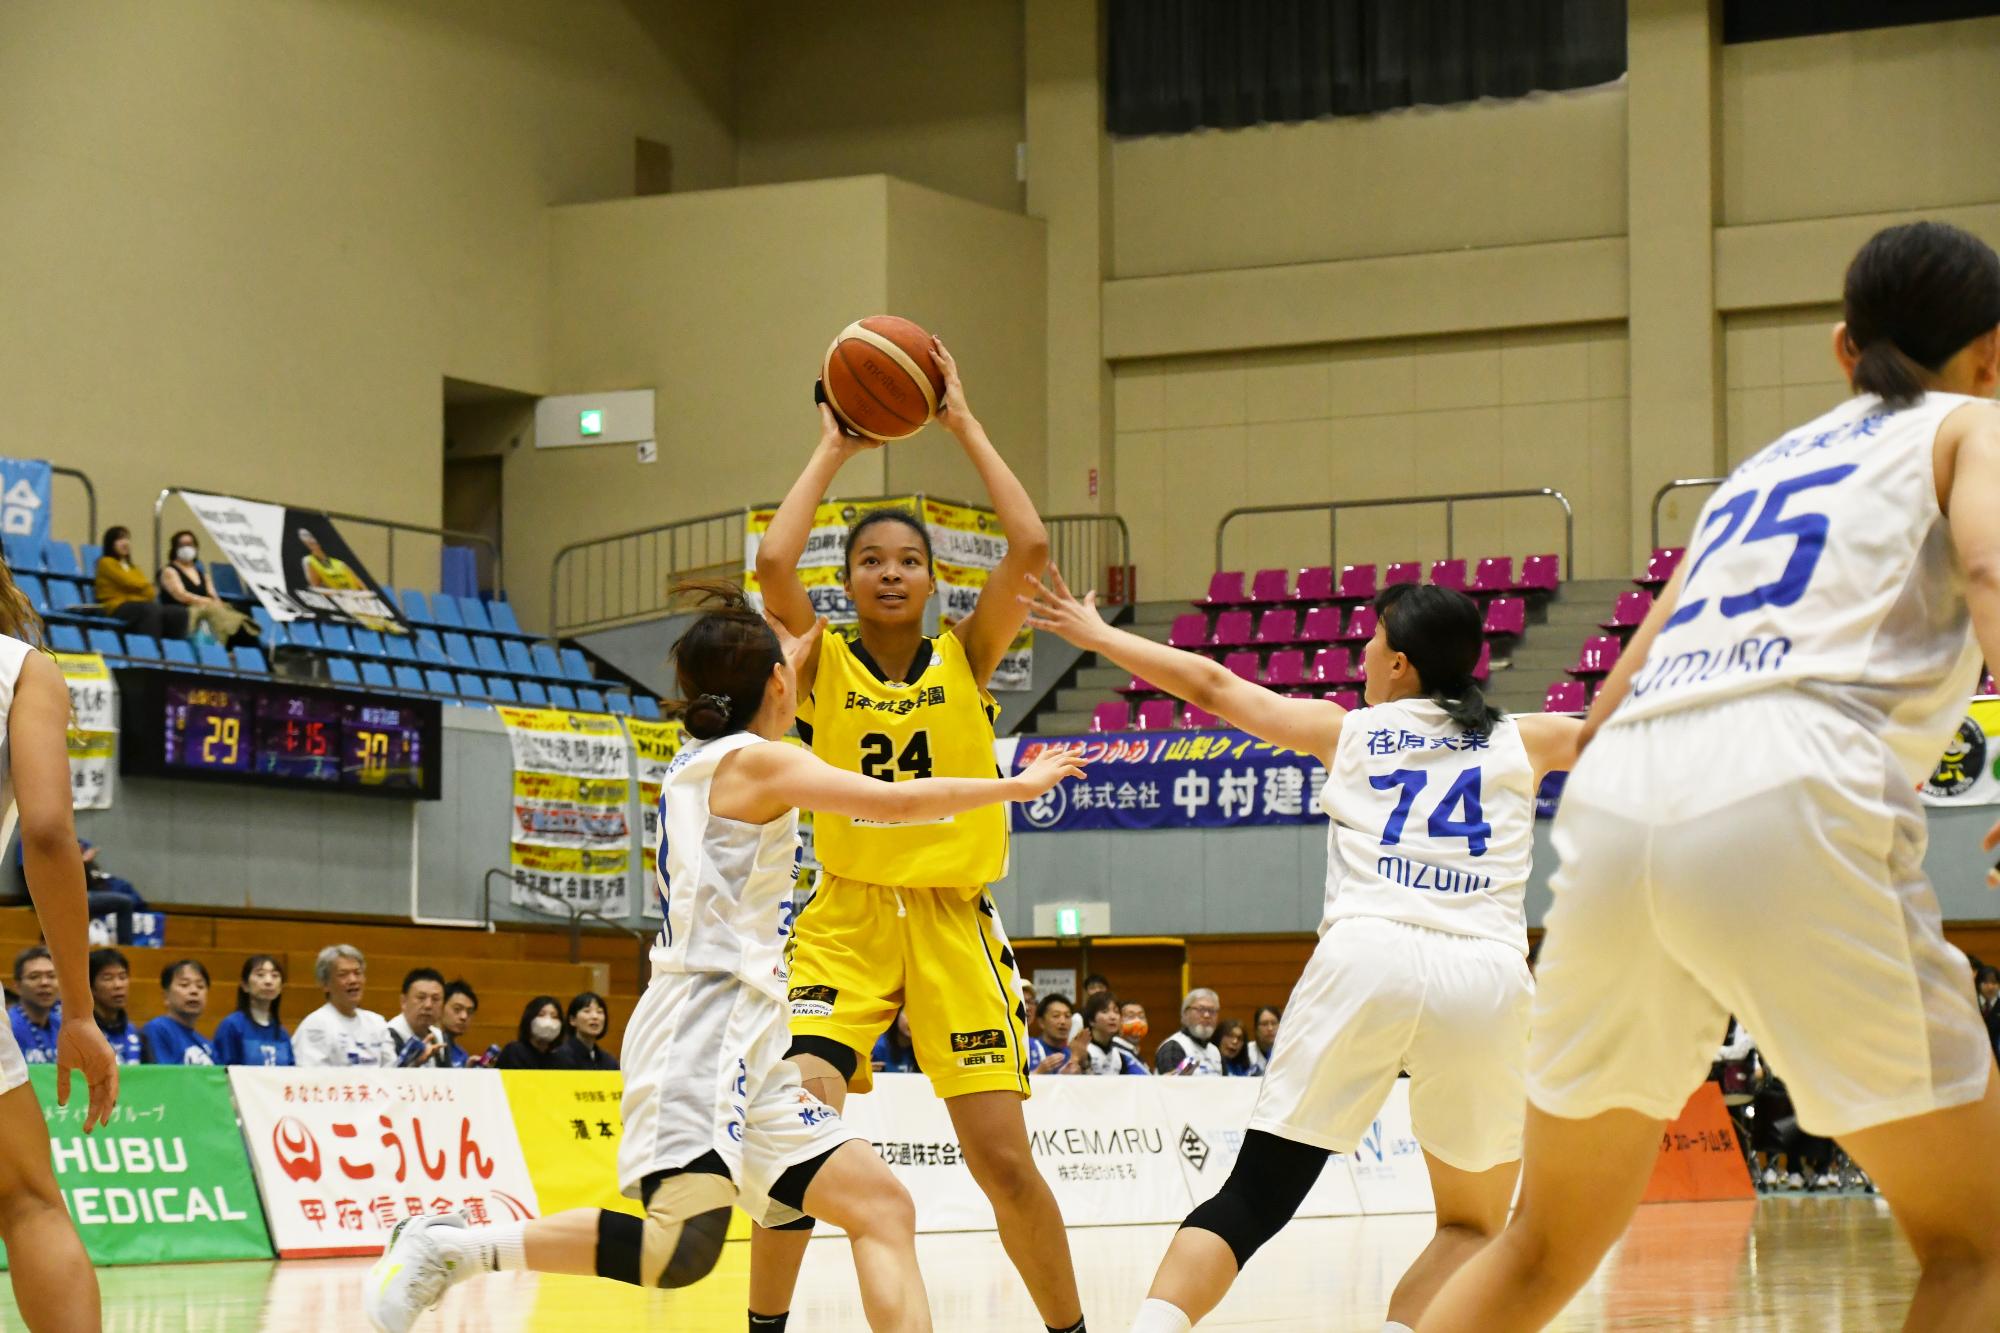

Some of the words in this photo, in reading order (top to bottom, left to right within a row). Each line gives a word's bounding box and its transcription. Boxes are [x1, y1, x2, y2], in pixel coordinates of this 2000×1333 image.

[1661, 464, 1860, 633] 25
[845, 686, 945, 715] 日本航空学園
[202, 716, 240, 764] 29
[861, 730, 932, 782] 24
[1072, 782, 1160, 810] 株式会社
[1369, 766, 1492, 857] 74
[285, 1085, 388, 1103] あなたの未来へ
[51, 1137, 188, 1174] HUBU
[332, 1115, 494, 1183] こうしん
